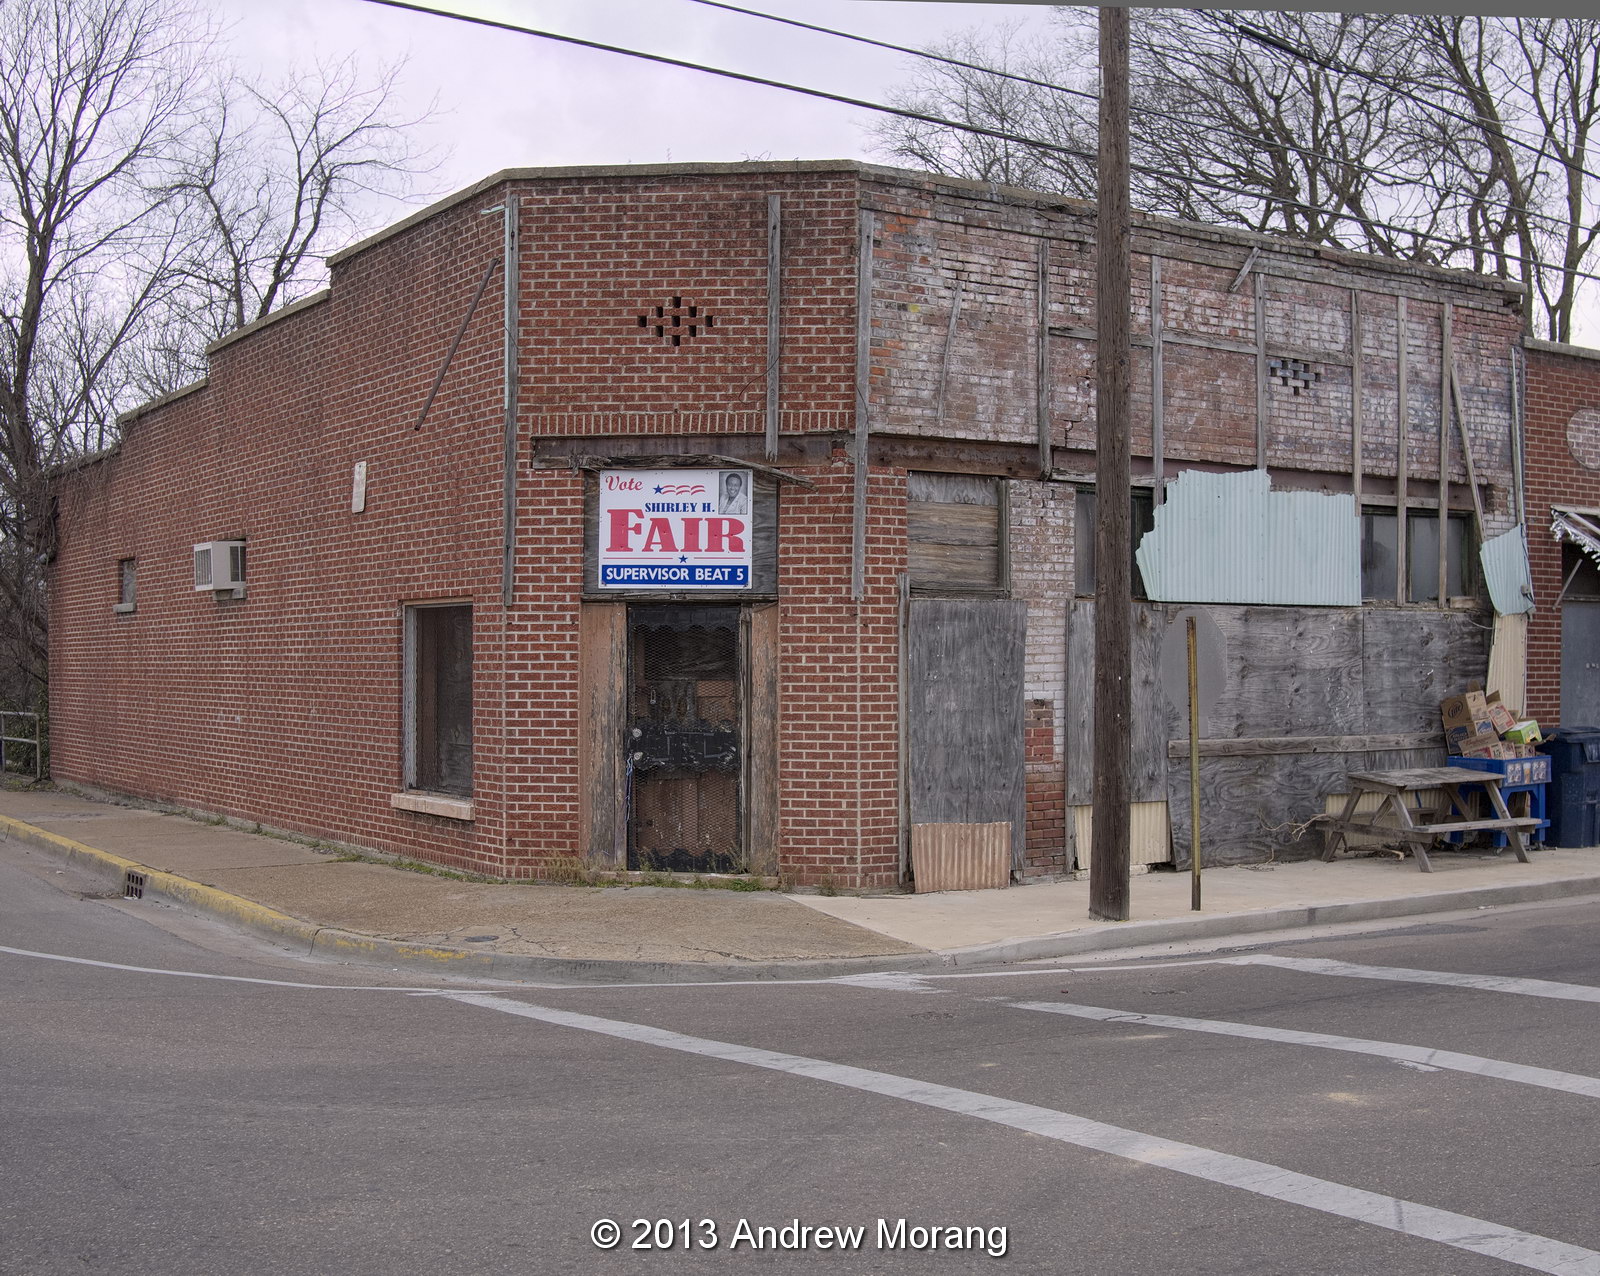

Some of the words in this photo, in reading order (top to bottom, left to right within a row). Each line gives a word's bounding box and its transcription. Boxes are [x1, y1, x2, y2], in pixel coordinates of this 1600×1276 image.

[605, 475, 644, 491] Vote
[644, 502, 698, 513] SHIRLEY
[701, 502, 715, 513] H.
[605, 509, 746, 553] FAIR
[606, 567, 690, 581] SUPERVISOR
[695, 568, 732, 581] BEAT
[736, 568, 744, 581] 5
